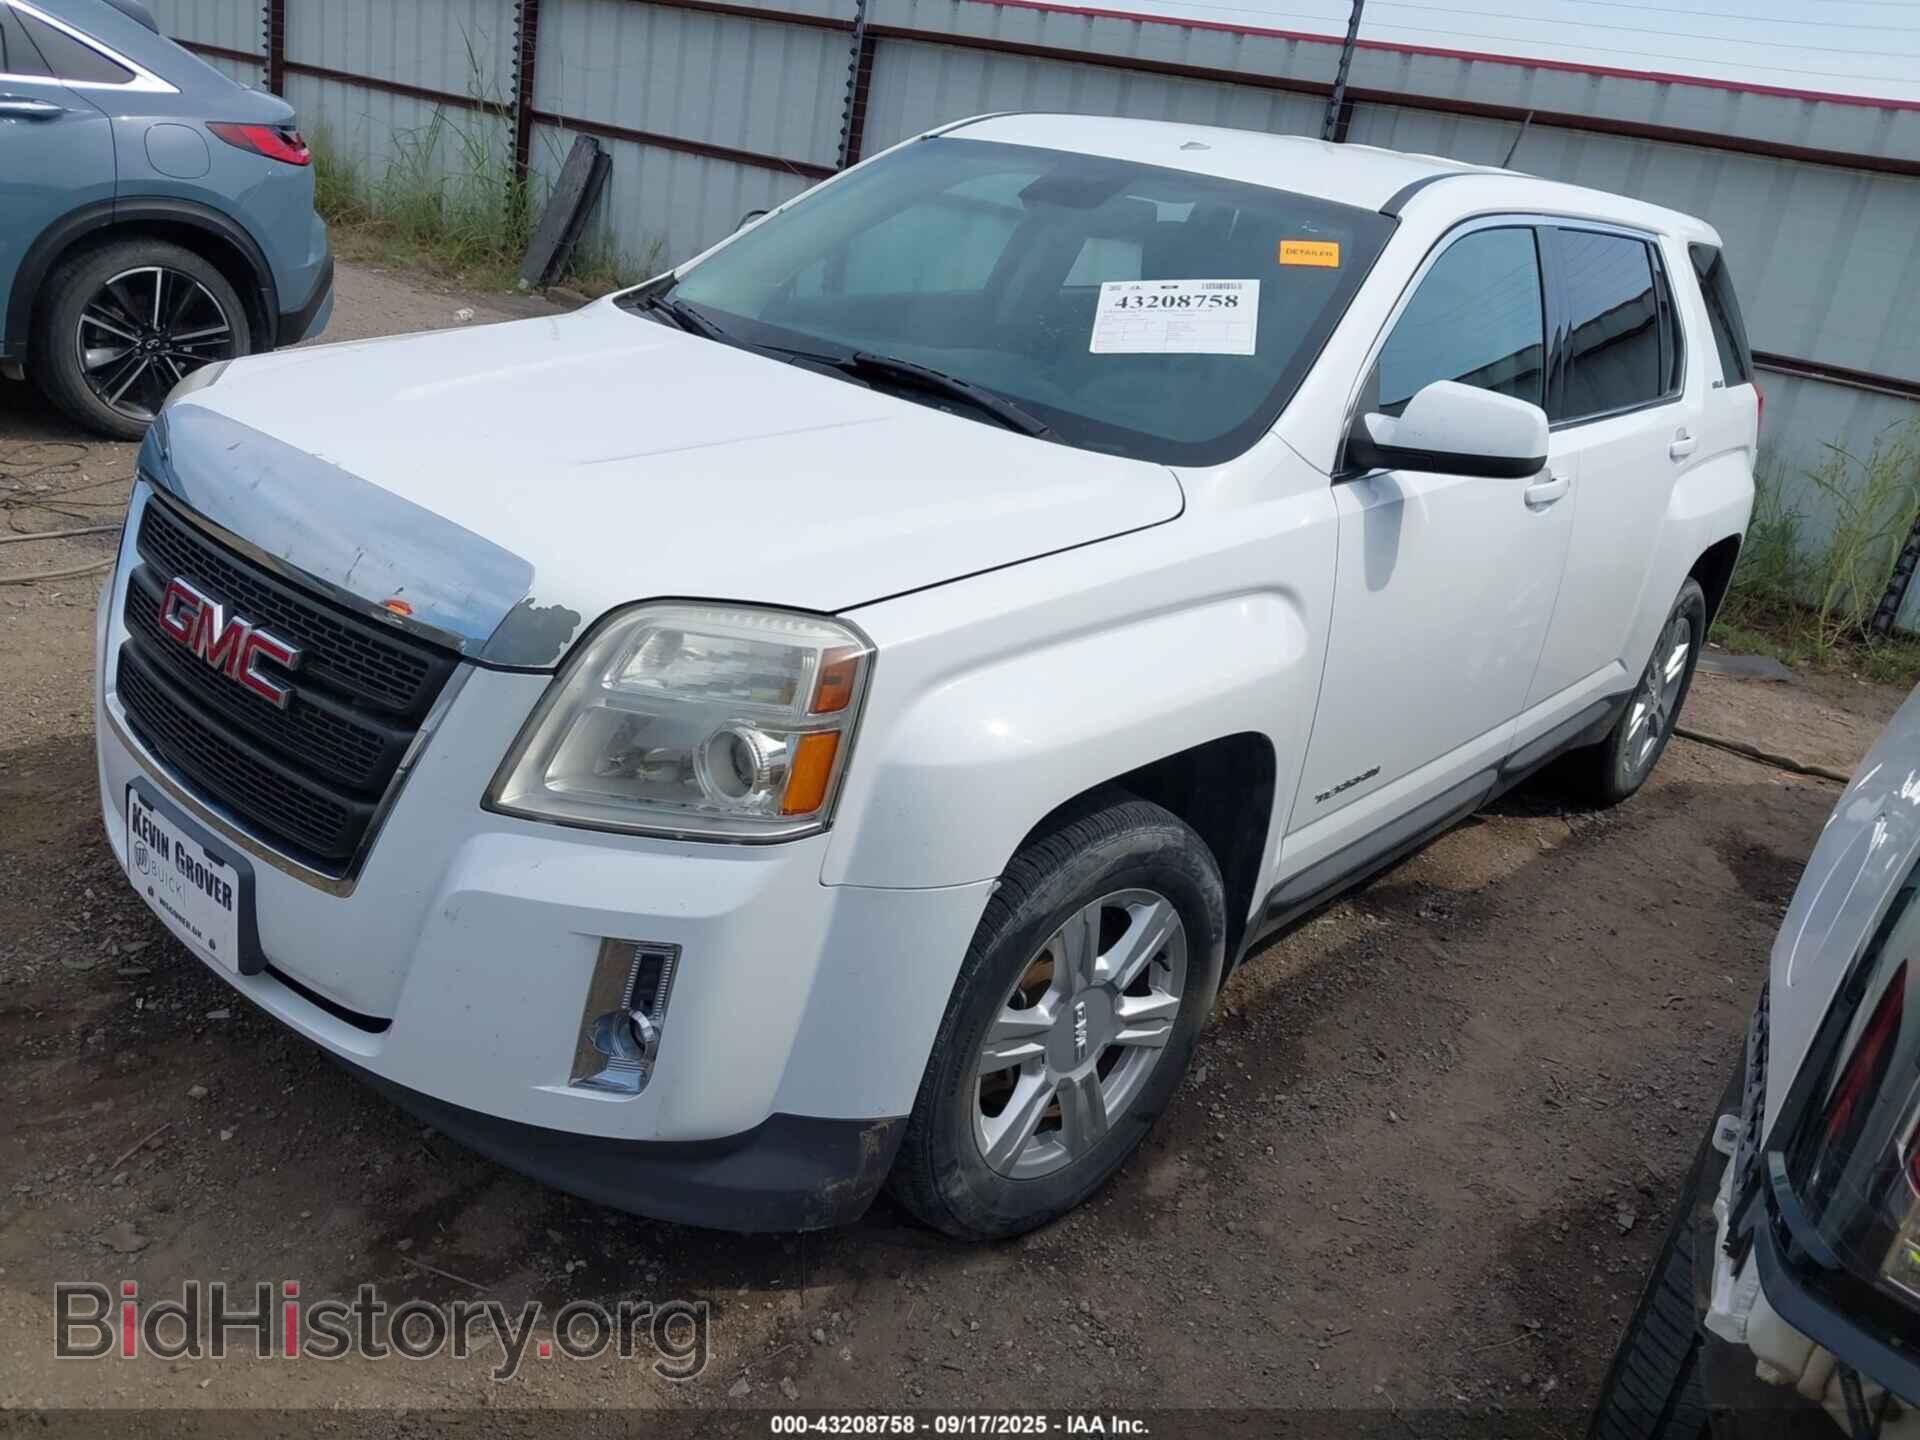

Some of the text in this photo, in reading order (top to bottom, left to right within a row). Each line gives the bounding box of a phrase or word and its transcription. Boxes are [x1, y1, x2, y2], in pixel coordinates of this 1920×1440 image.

[1114, 294, 1239, 309] 43208758
[160, 577, 298, 709] GMC
[132, 801, 232, 912] KEVIN GROVER
